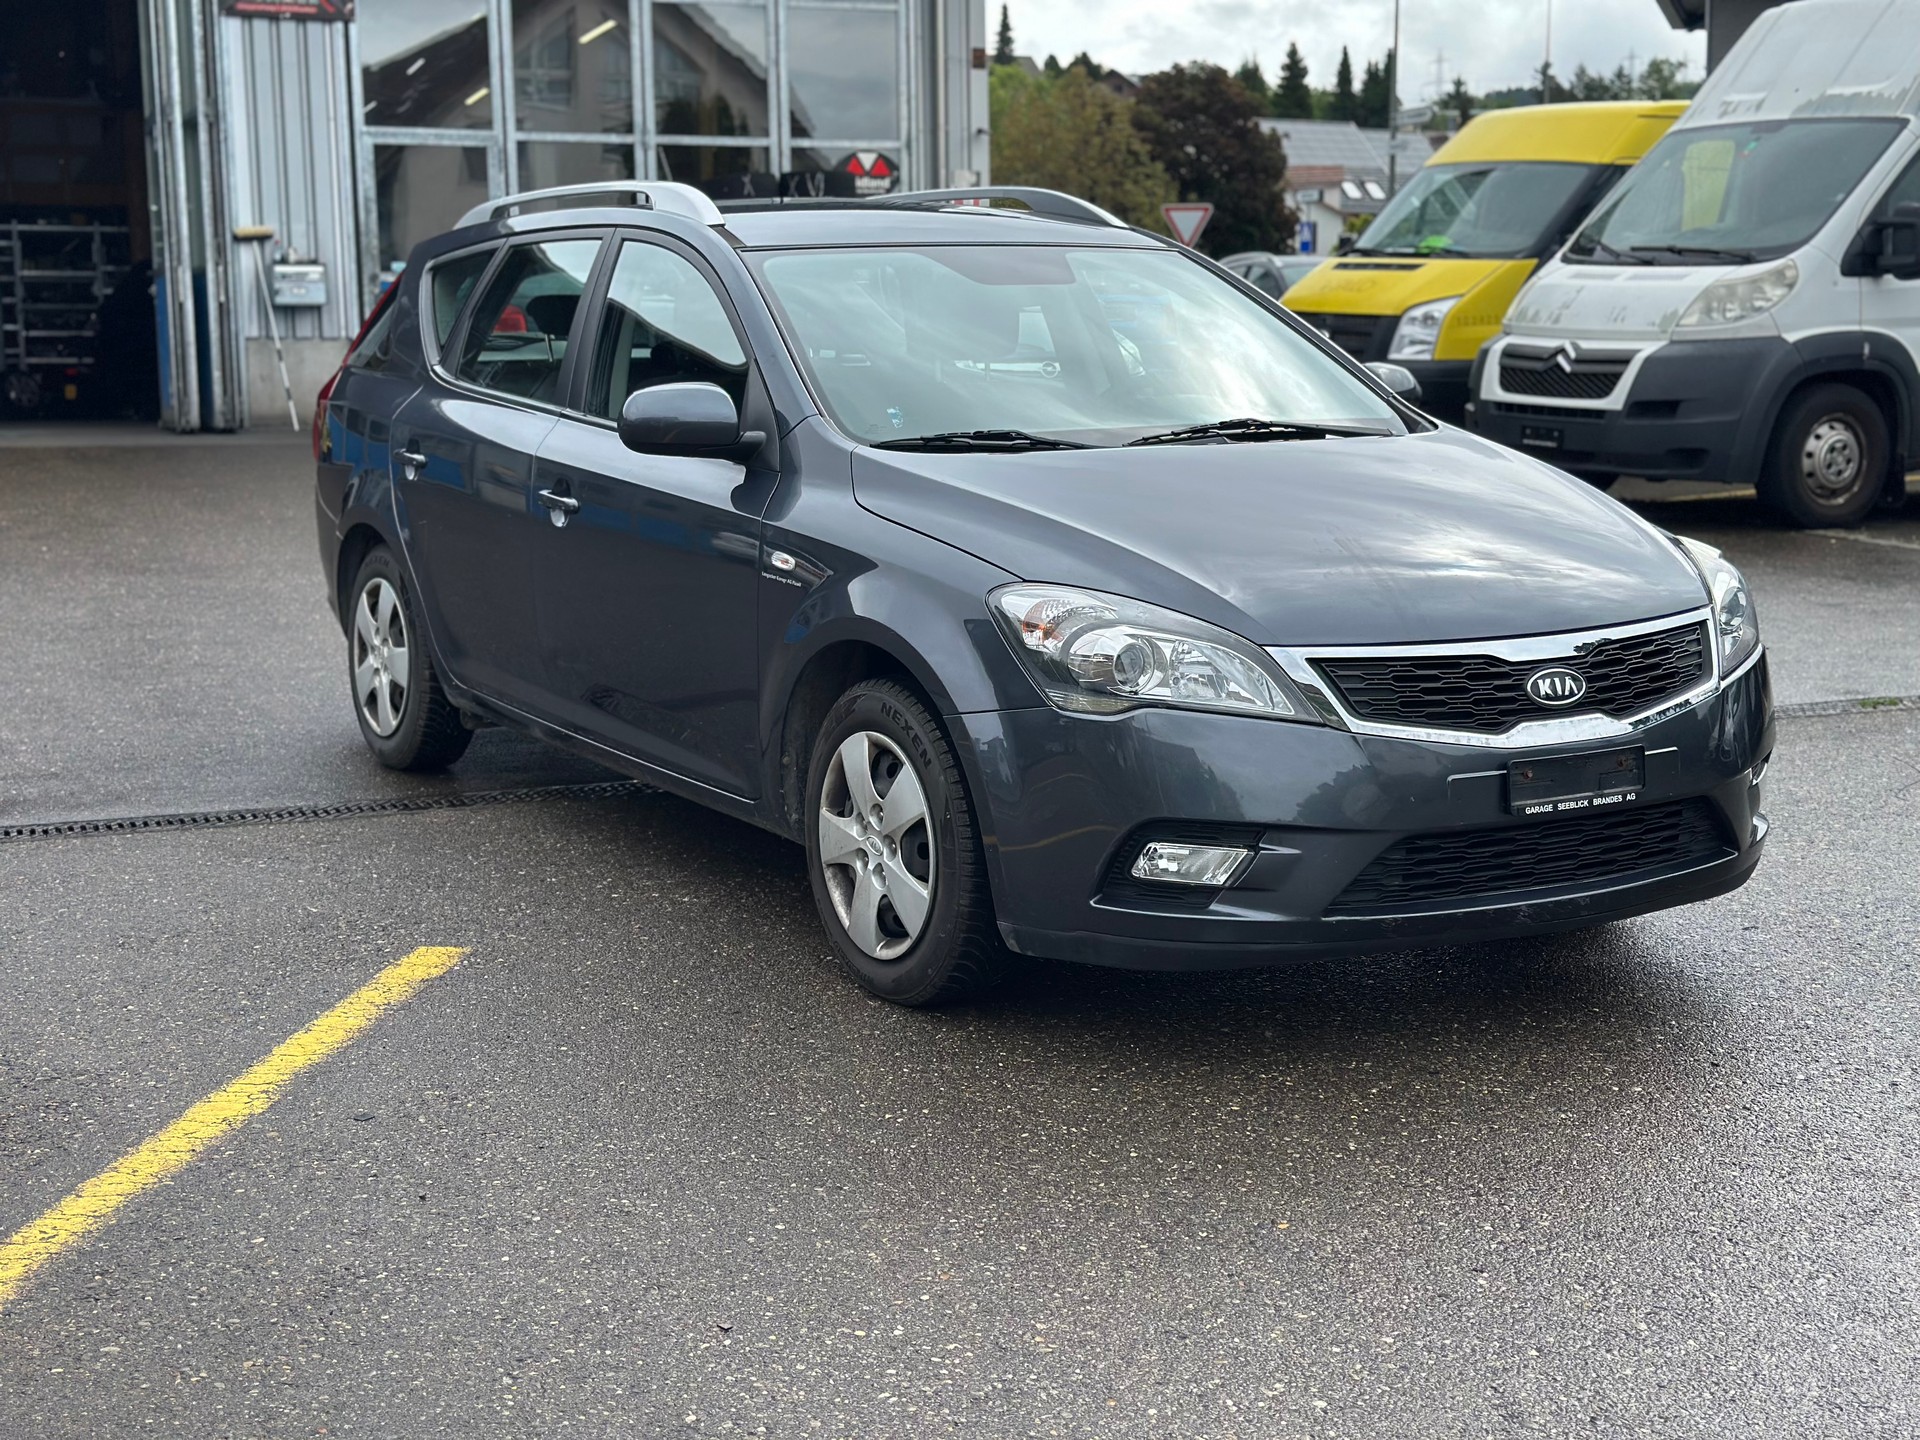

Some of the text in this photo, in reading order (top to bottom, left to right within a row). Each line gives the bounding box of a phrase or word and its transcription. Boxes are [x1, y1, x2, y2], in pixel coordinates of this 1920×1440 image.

[1536, 676, 1579, 698] KIA
[880, 701, 932, 769] NEXEN
[1525, 792, 1636, 815] GARAGE SEEBLICK BRANDES AG
